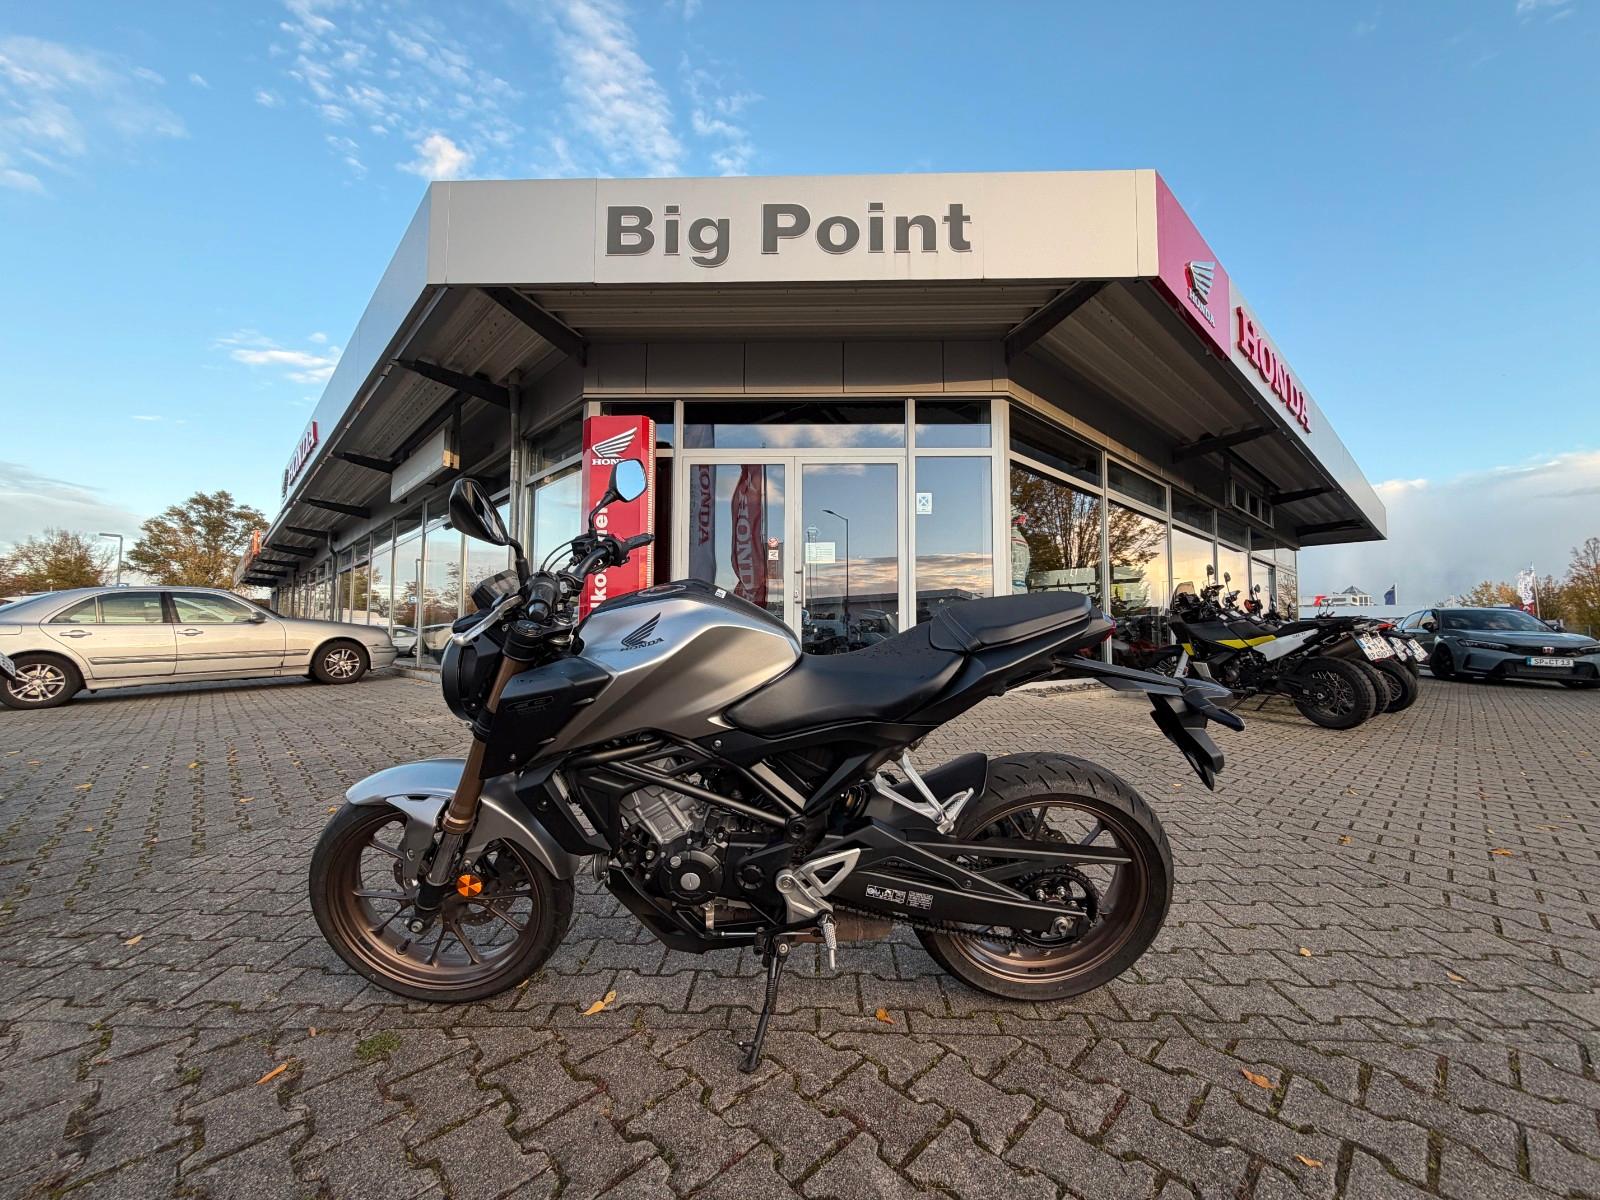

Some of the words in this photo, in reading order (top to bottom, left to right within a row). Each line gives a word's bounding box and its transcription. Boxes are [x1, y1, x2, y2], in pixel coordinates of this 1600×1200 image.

[605, 204, 731, 268] Big
[761, 200, 973, 255] Point
[1187, 288, 1216, 329] HONDA
[1236, 306, 1312, 434] HONDA
[592, 458, 626, 466] HON
[620, 637, 665, 652] HONDA
